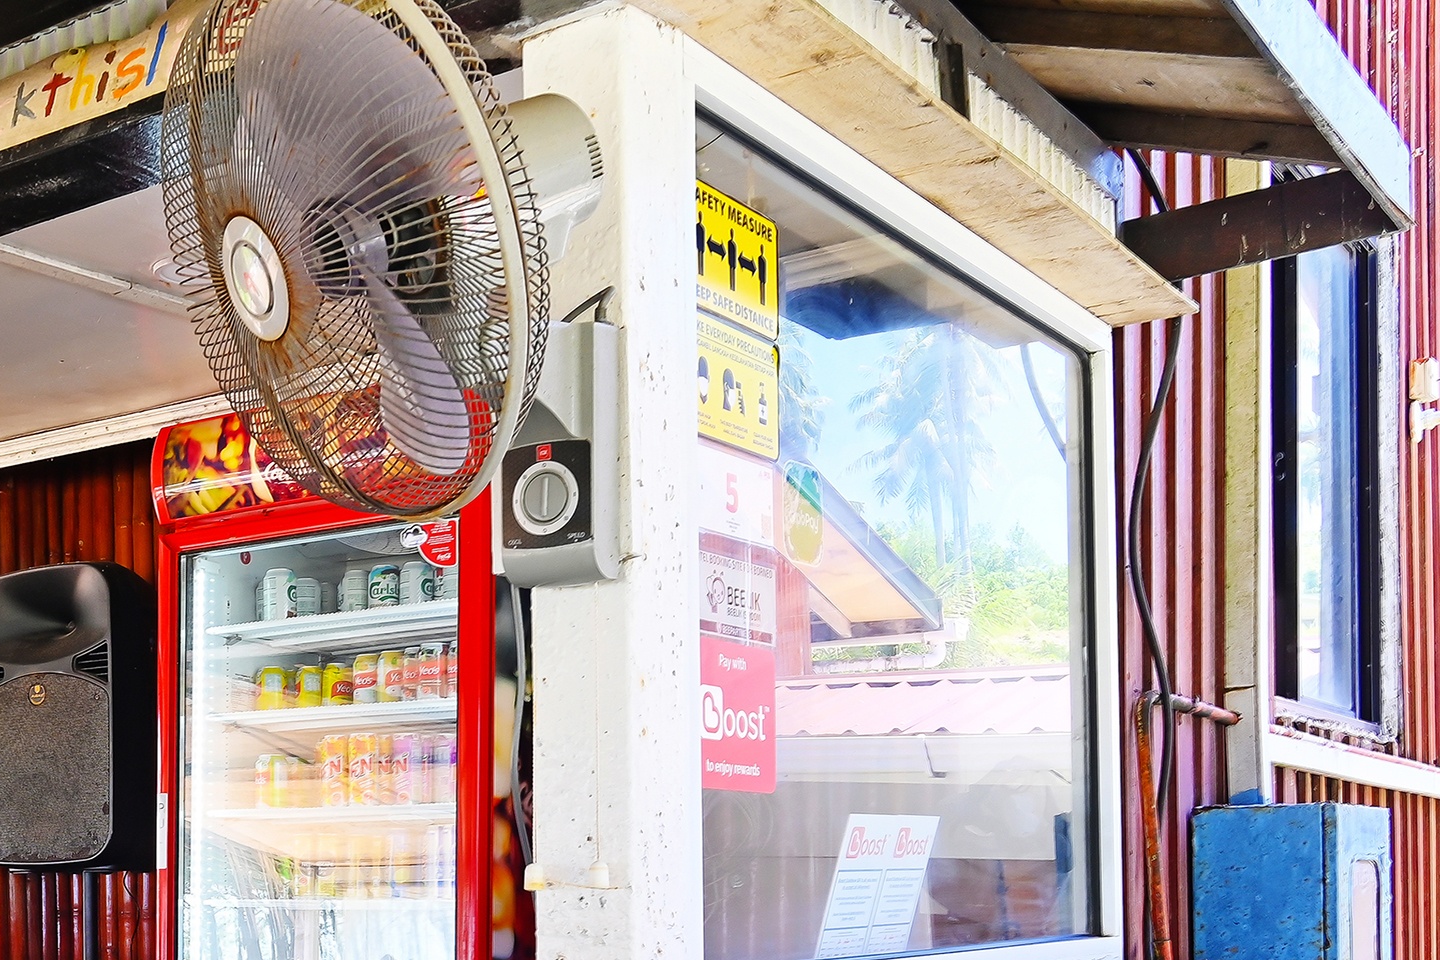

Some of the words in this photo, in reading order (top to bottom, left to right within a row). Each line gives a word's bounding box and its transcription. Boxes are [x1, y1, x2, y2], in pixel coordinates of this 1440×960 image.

[696, 187, 726, 216] AFETY
[728, 205, 773, 242] MEASURE
[696, 284, 711, 301] EEP
[713, 291, 734, 313] SAFE
[735, 302, 774, 333] DISTANCE
[706, 324, 736, 347] EVERYDAY
[736, 338, 775, 364] PRECAUTIONS
[725, 472, 739, 513] 5
[719, 653, 731, 671] Pay
[732, 657, 747, 671] with
[700, 684, 767, 742] Boost
[706, 758, 714, 772] to
[715, 760, 734, 777] enjoy
[734, 763, 761, 776] rewards
[846, 826, 887, 859] Boost
[893, 827, 929, 858] Boost
